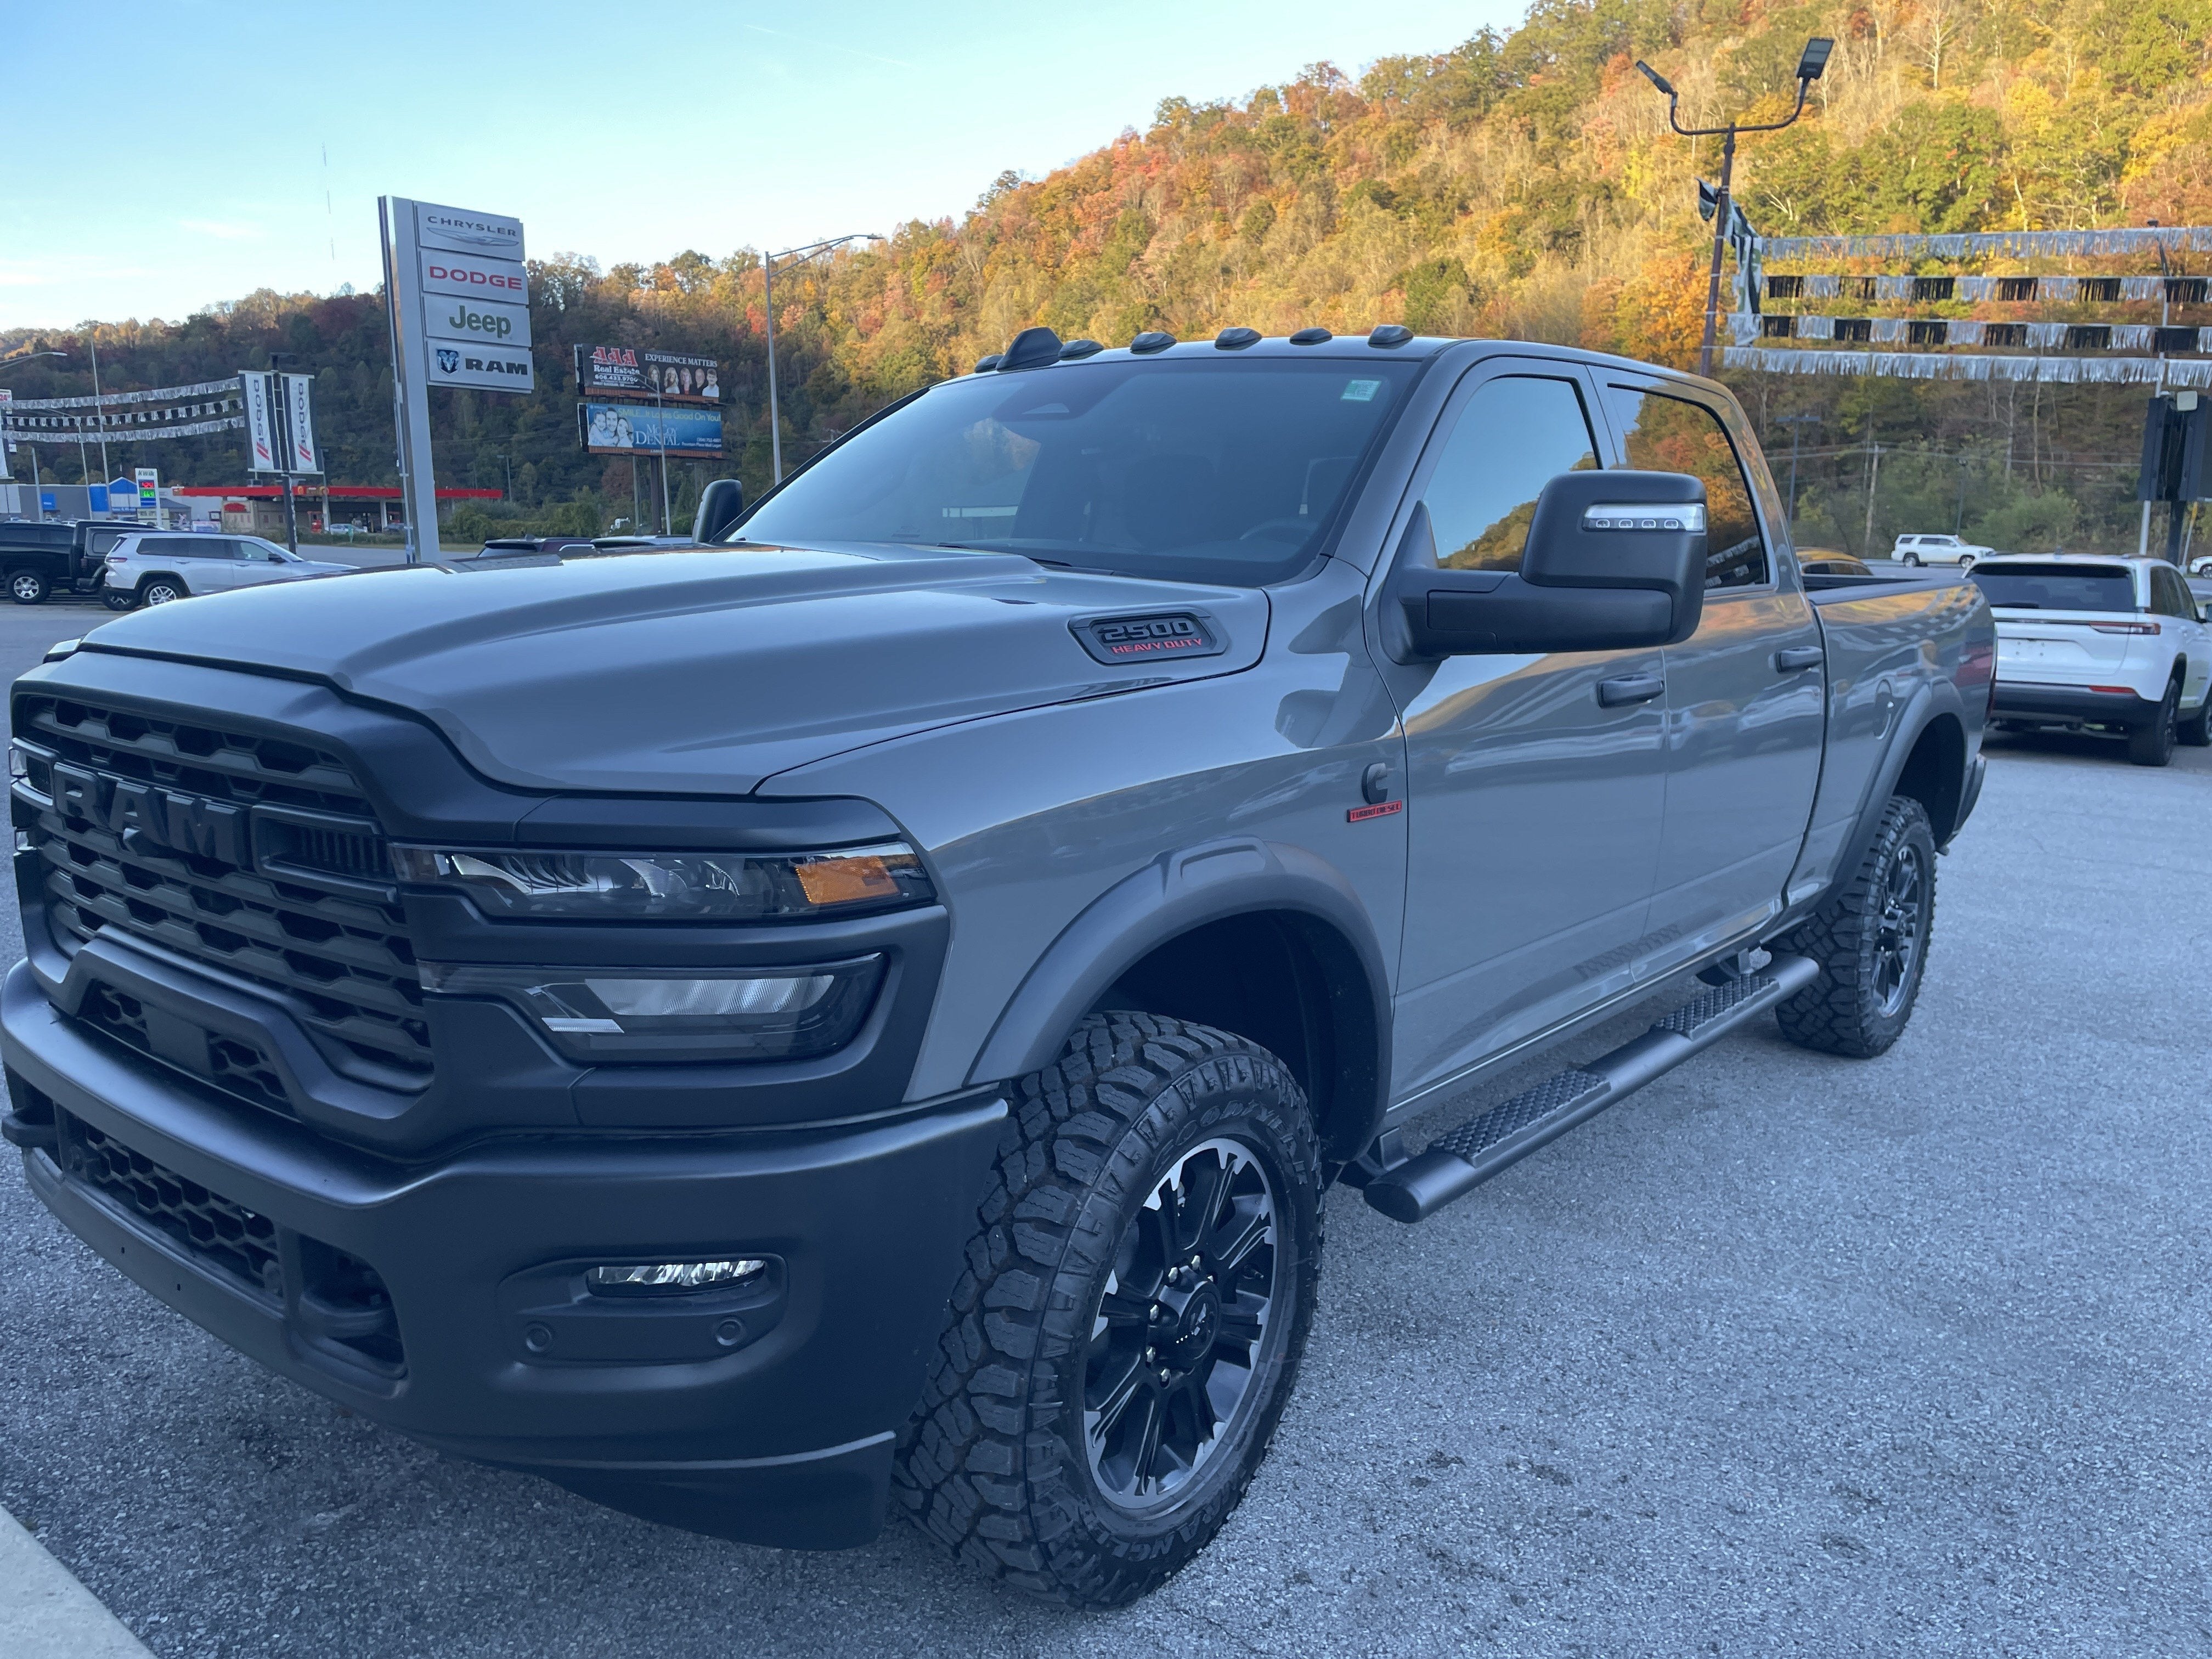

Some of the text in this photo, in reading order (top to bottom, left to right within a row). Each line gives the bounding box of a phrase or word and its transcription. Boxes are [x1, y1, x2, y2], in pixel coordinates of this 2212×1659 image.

[427, 216, 517, 236] CHRYSLER
[430, 266, 522, 290] DODGE
[449, 305, 511, 338] Jeep
[465, 358, 528, 375] RAM
[592, 346, 638, 367] AAA
[645, 353, 718, 368] EXPERIENCE MATTERS
[594, 364, 640, 375] Real Estate
[673, 411, 693, 420] Good
[694, 412, 706, 421] On
[706, 413, 721, 422] You!
[1099, 620, 1195, 643] 2500
[1111, 637, 1203, 654] HEAVY DUTY
[54, 761, 250, 870] RAM
